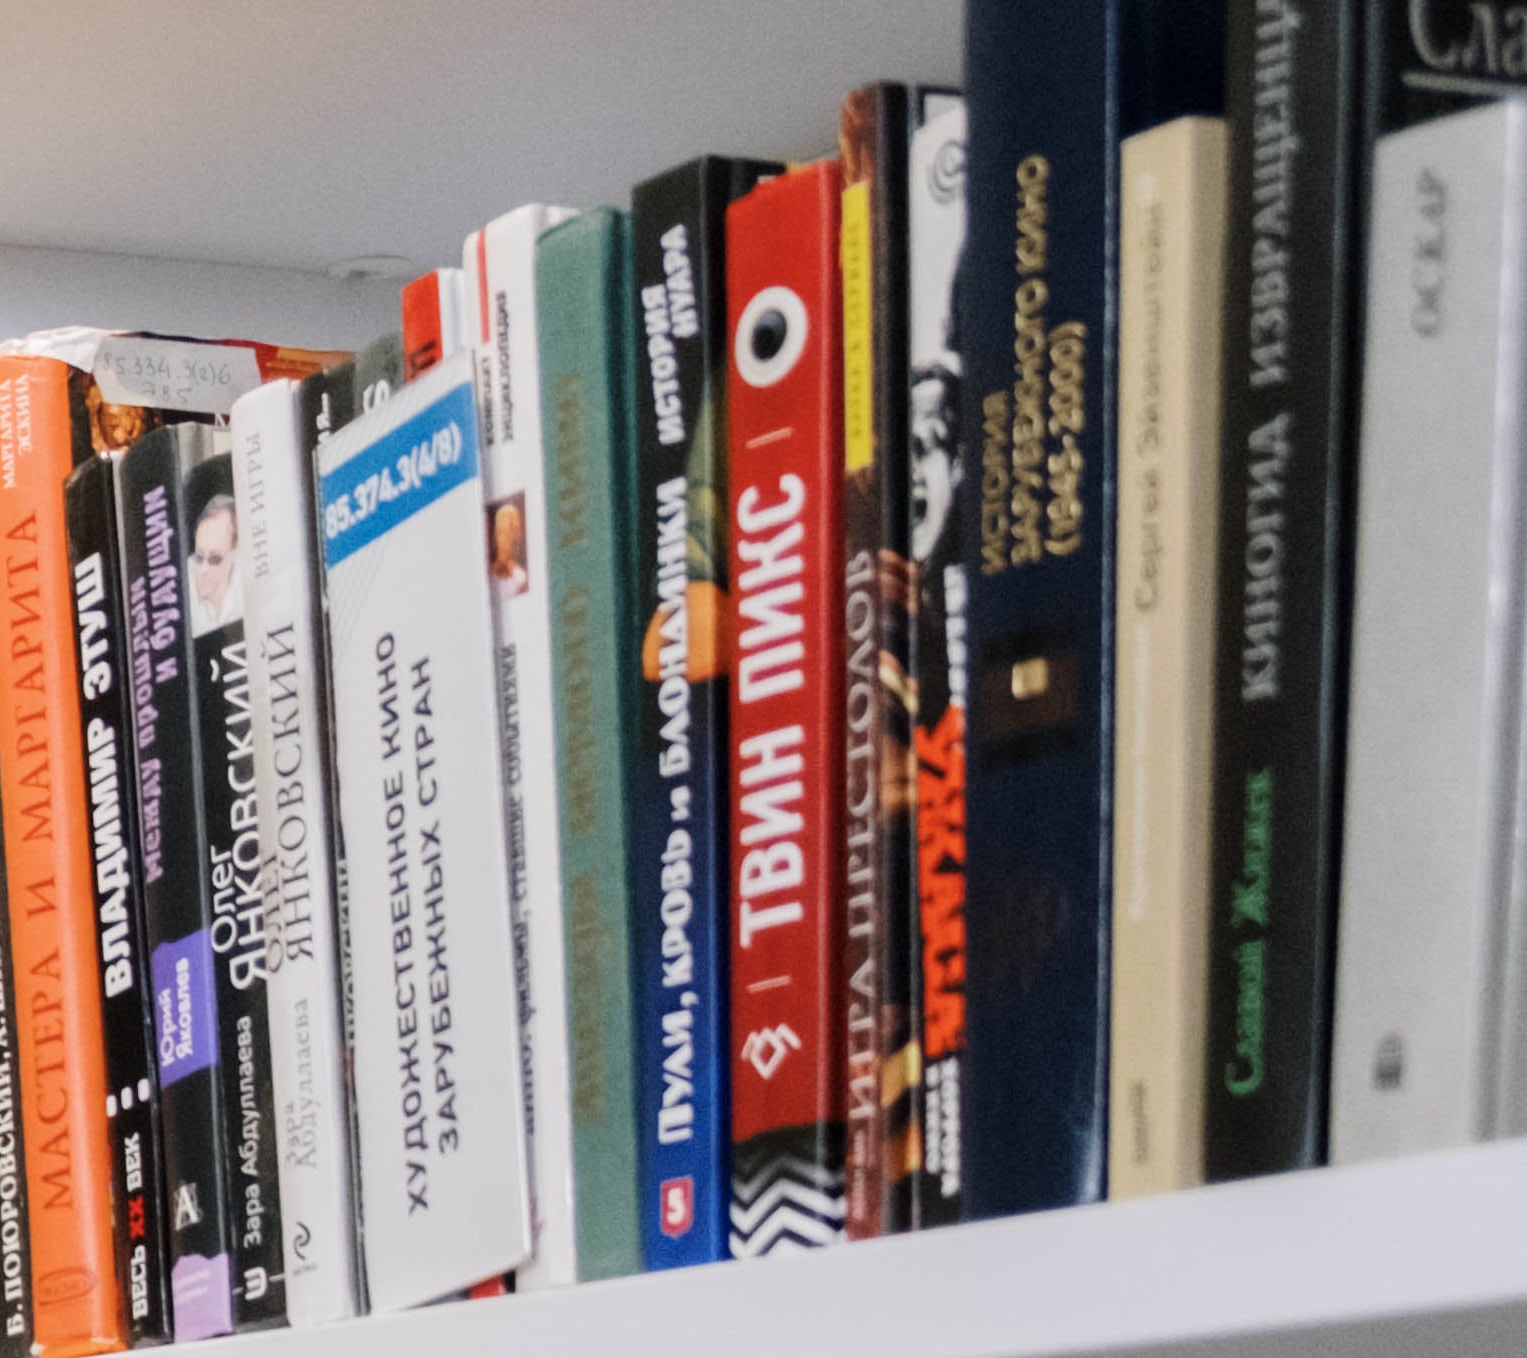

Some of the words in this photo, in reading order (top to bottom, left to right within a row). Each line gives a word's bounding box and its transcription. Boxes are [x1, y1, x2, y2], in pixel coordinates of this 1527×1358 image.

[661, 224, 698, 337] НУАРА
[1016, 158, 1048, 271] КИНО
[2, 380, 16, 490] МАРГАРИТА
[642, 284, 685, 445] ИСТОРИЯ
[1014, 279, 1046, 566] ЗАРУБЕЖНОГО
[324, 421, 465, 539] 85.374.3(4/8)
[981, 392, 1010, 574] ИСТОРИЯ
[74, 553, 108, 694] ЭТУШ
[737, 473, 807, 702] ПИКС
[4, 512, 58, 843] МАРГАРИТА
[374, 632, 403, 758] КИНО
[410, 656, 437, 806] СТРАН
[845, 552, 877, 937] ПРЕСТОЛОВ
[88, 719, 134, 998] ВЛАДИМИР
[209, 639, 268, 991] ЯНКОВСКИЙ
[266, 621, 315, 962] ЯНКОВСКИЙ
[737, 727, 807, 948] ТВИН
[30, 876, 55, 913] И
[208, 845, 239, 952] Олег
[172, 958, 195, 1059] Яковлев
[382, 771, 429, 1214] ХУДОЖЕСТВЕННОЕ
[418, 821, 461, 1153] ЗАРУБЕЖНЫХ
[849, 962, 879, 1120] ИГРА
[34, 950, 73, 1209] МАСТЕРА
[233, 1016, 260, 1176] Абдуллаева
[122, 1134, 143, 1190] ВЕК
[241, 1182, 263, 1248] Зара
